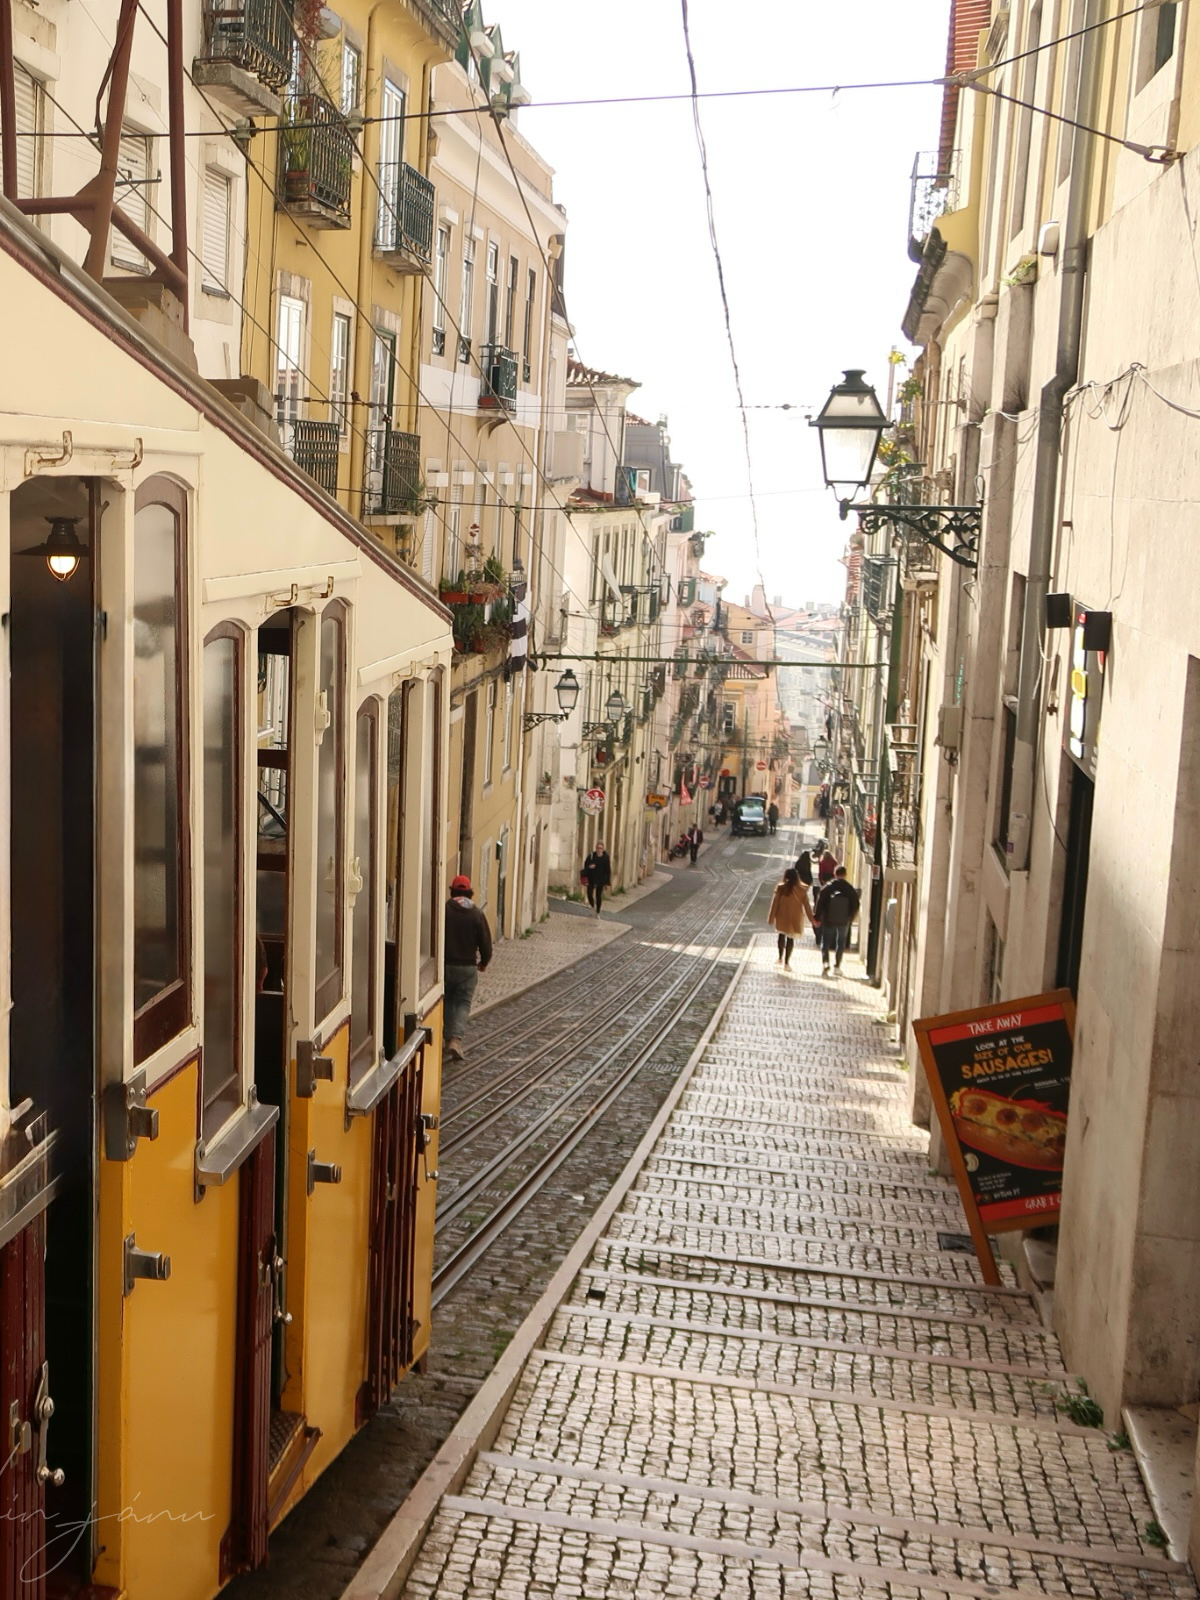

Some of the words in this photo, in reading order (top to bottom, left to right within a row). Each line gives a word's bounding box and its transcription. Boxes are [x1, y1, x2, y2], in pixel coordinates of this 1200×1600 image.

[967, 1020, 995, 1035] TAKE
[996, 1014, 1022, 1031] AWAY
[974, 1050, 994, 1061] SIZE
[997, 1046, 1009, 1056] OF
[1013, 1042, 1032, 1053] OUR
[975, 1042, 995, 1051] LOOK
[998, 1039, 1008, 1047] AT
[1010, 1035, 1025, 1044] THE
[961, 1048, 1053, 1079] SAUSAGES!
[1025, 1196, 1047, 1209] GRAB
